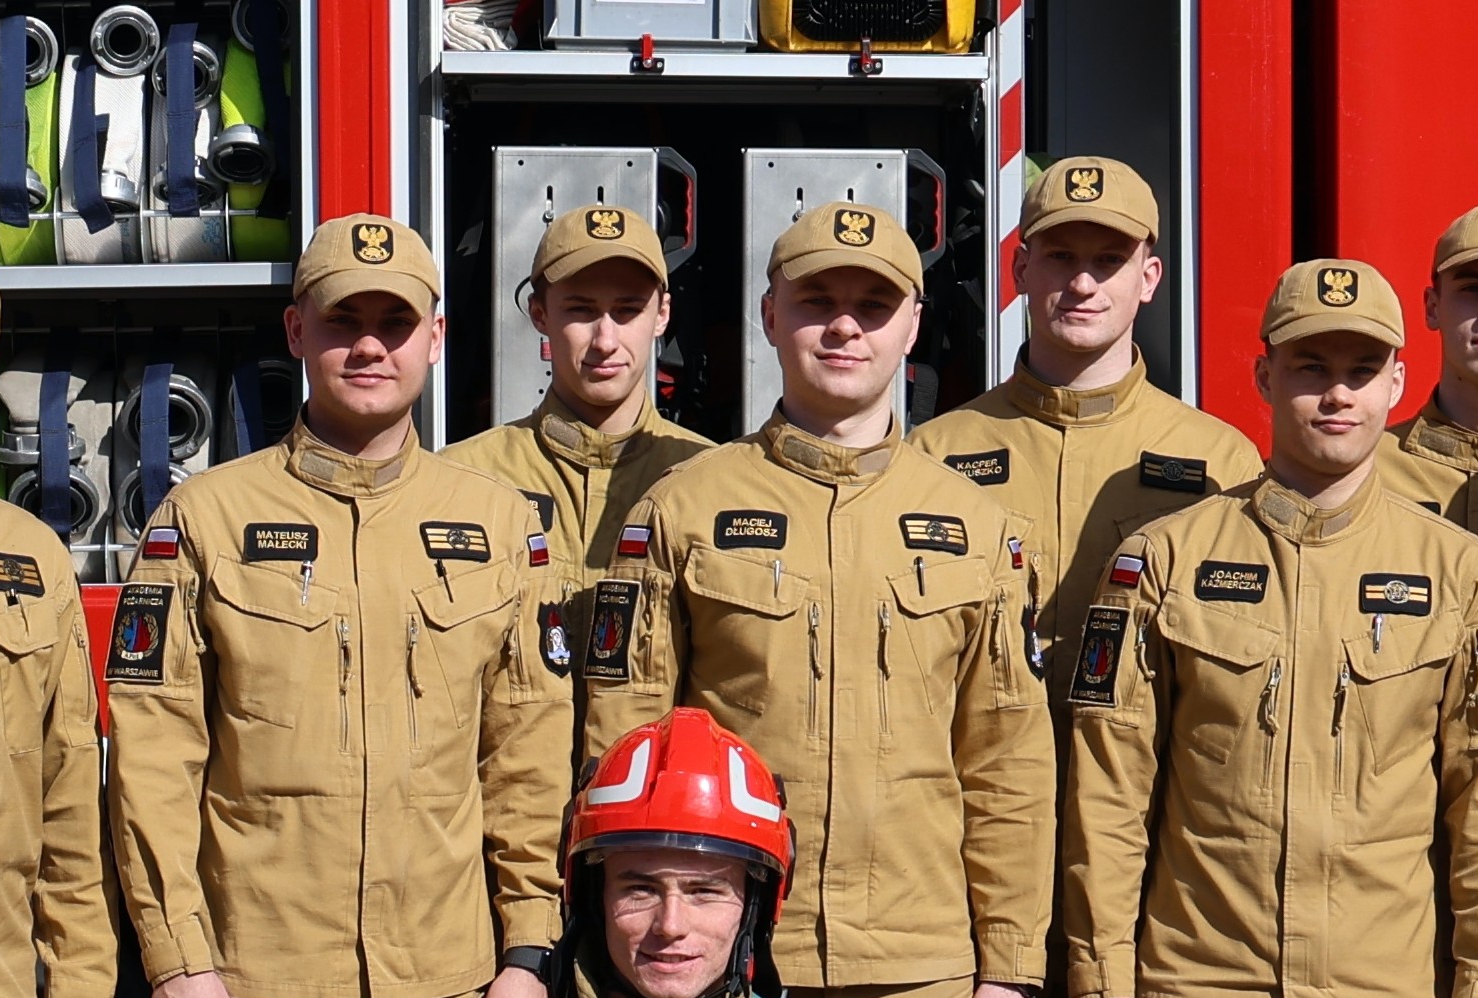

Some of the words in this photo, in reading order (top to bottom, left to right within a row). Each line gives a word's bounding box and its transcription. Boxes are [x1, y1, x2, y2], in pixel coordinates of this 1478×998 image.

[956, 458, 998, 470] KACPER
[732, 517, 772, 528] MACIEJ
[256, 530, 309, 541] MATEUSZ
[725, 526, 778, 538] DŁUGOSZ
[257, 539, 307, 550] MAŁECKI
[1209, 570, 1258, 581] JOACHIM
